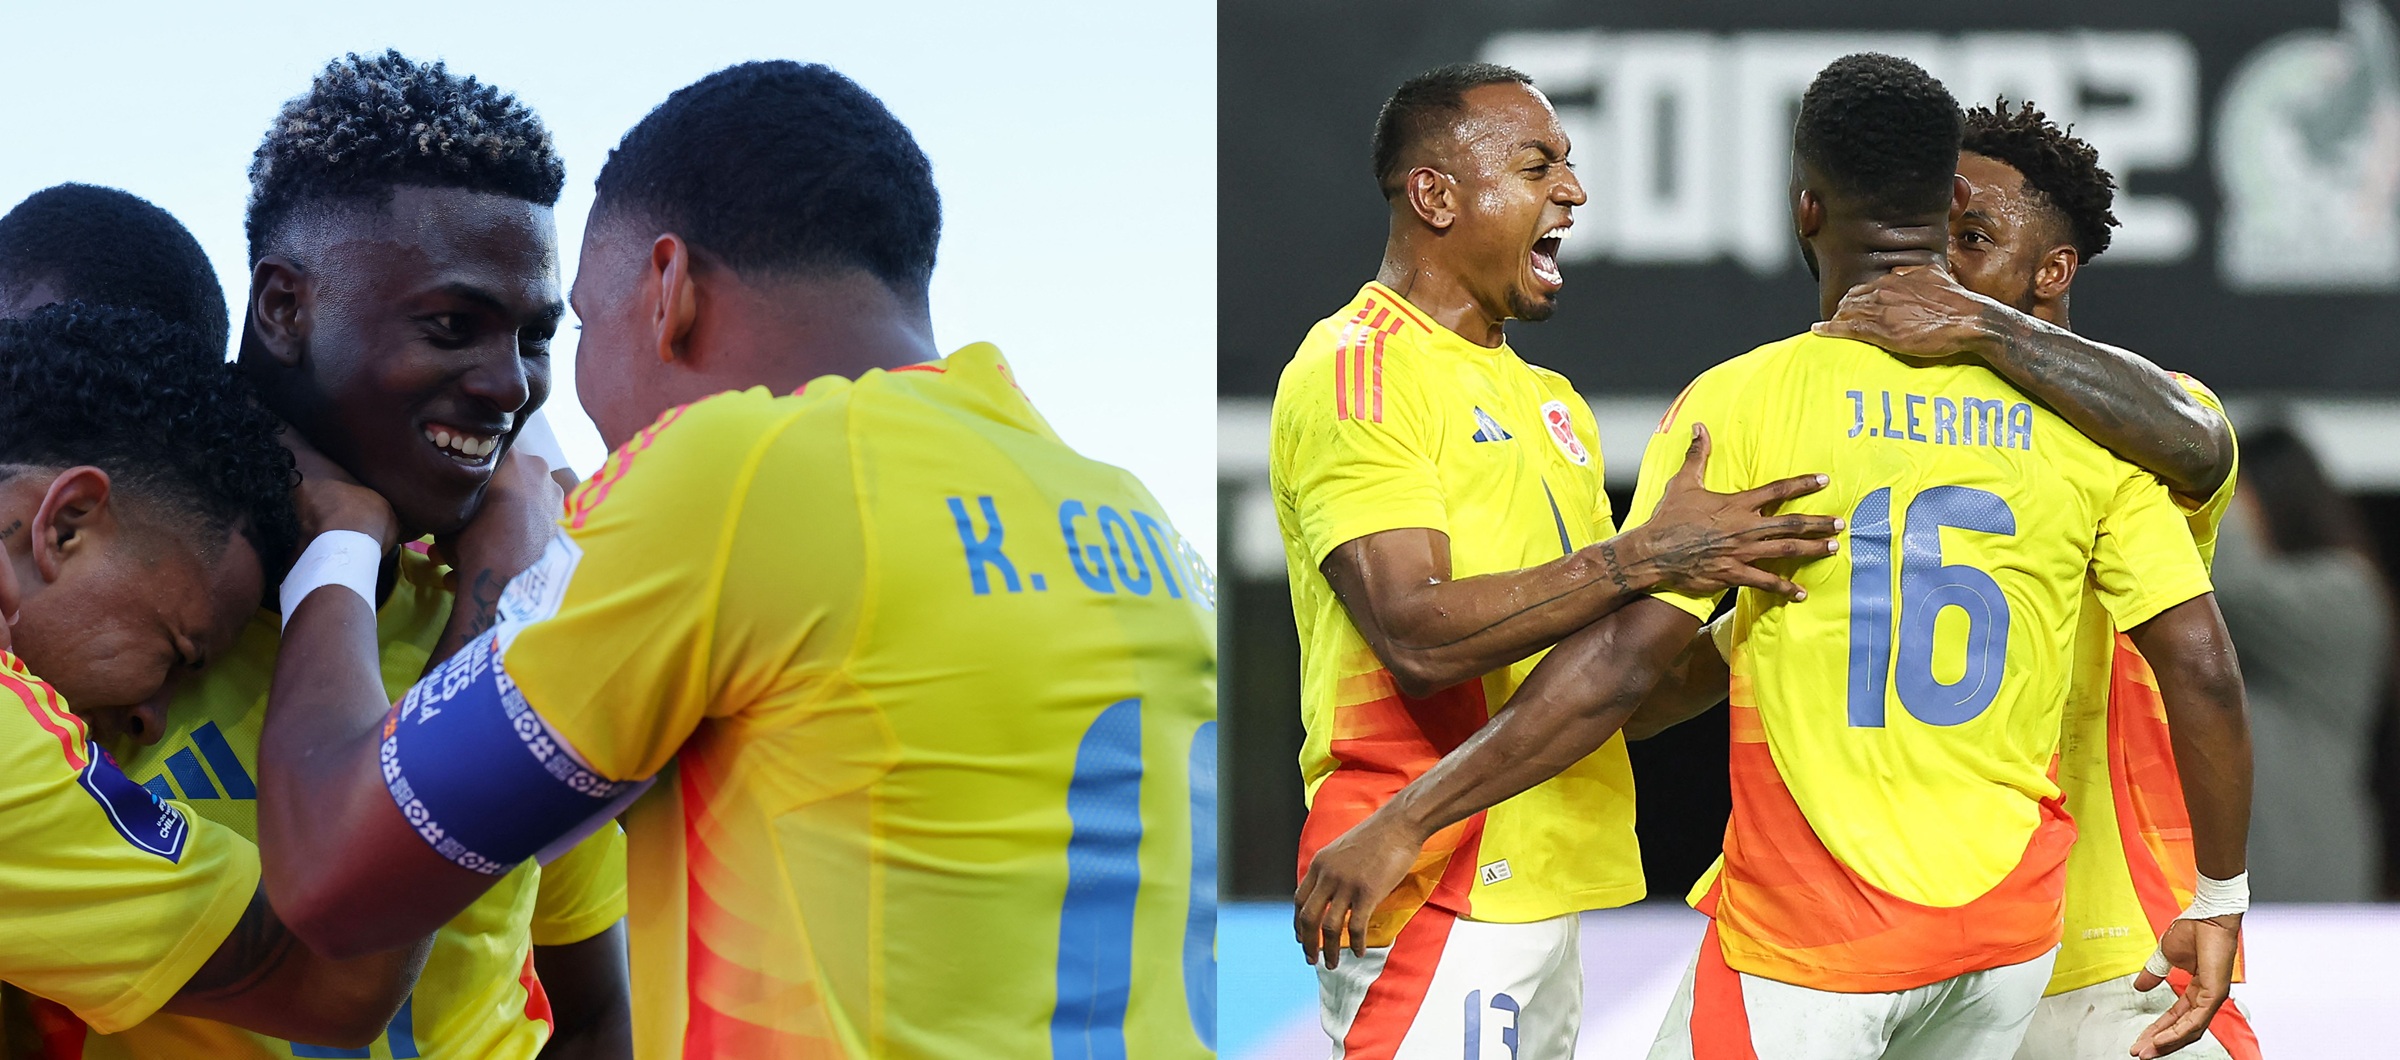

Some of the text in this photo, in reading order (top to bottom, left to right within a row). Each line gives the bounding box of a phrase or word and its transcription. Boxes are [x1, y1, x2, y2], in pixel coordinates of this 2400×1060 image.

[1846, 390, 2033, 451] J.LERMA
[945, 495, 1047, 595] K.
[1847, 485, 2016, 728] 16
[1050, 697, 1217, 1060] 1
[1464, 989, 1520, 1060] 13
